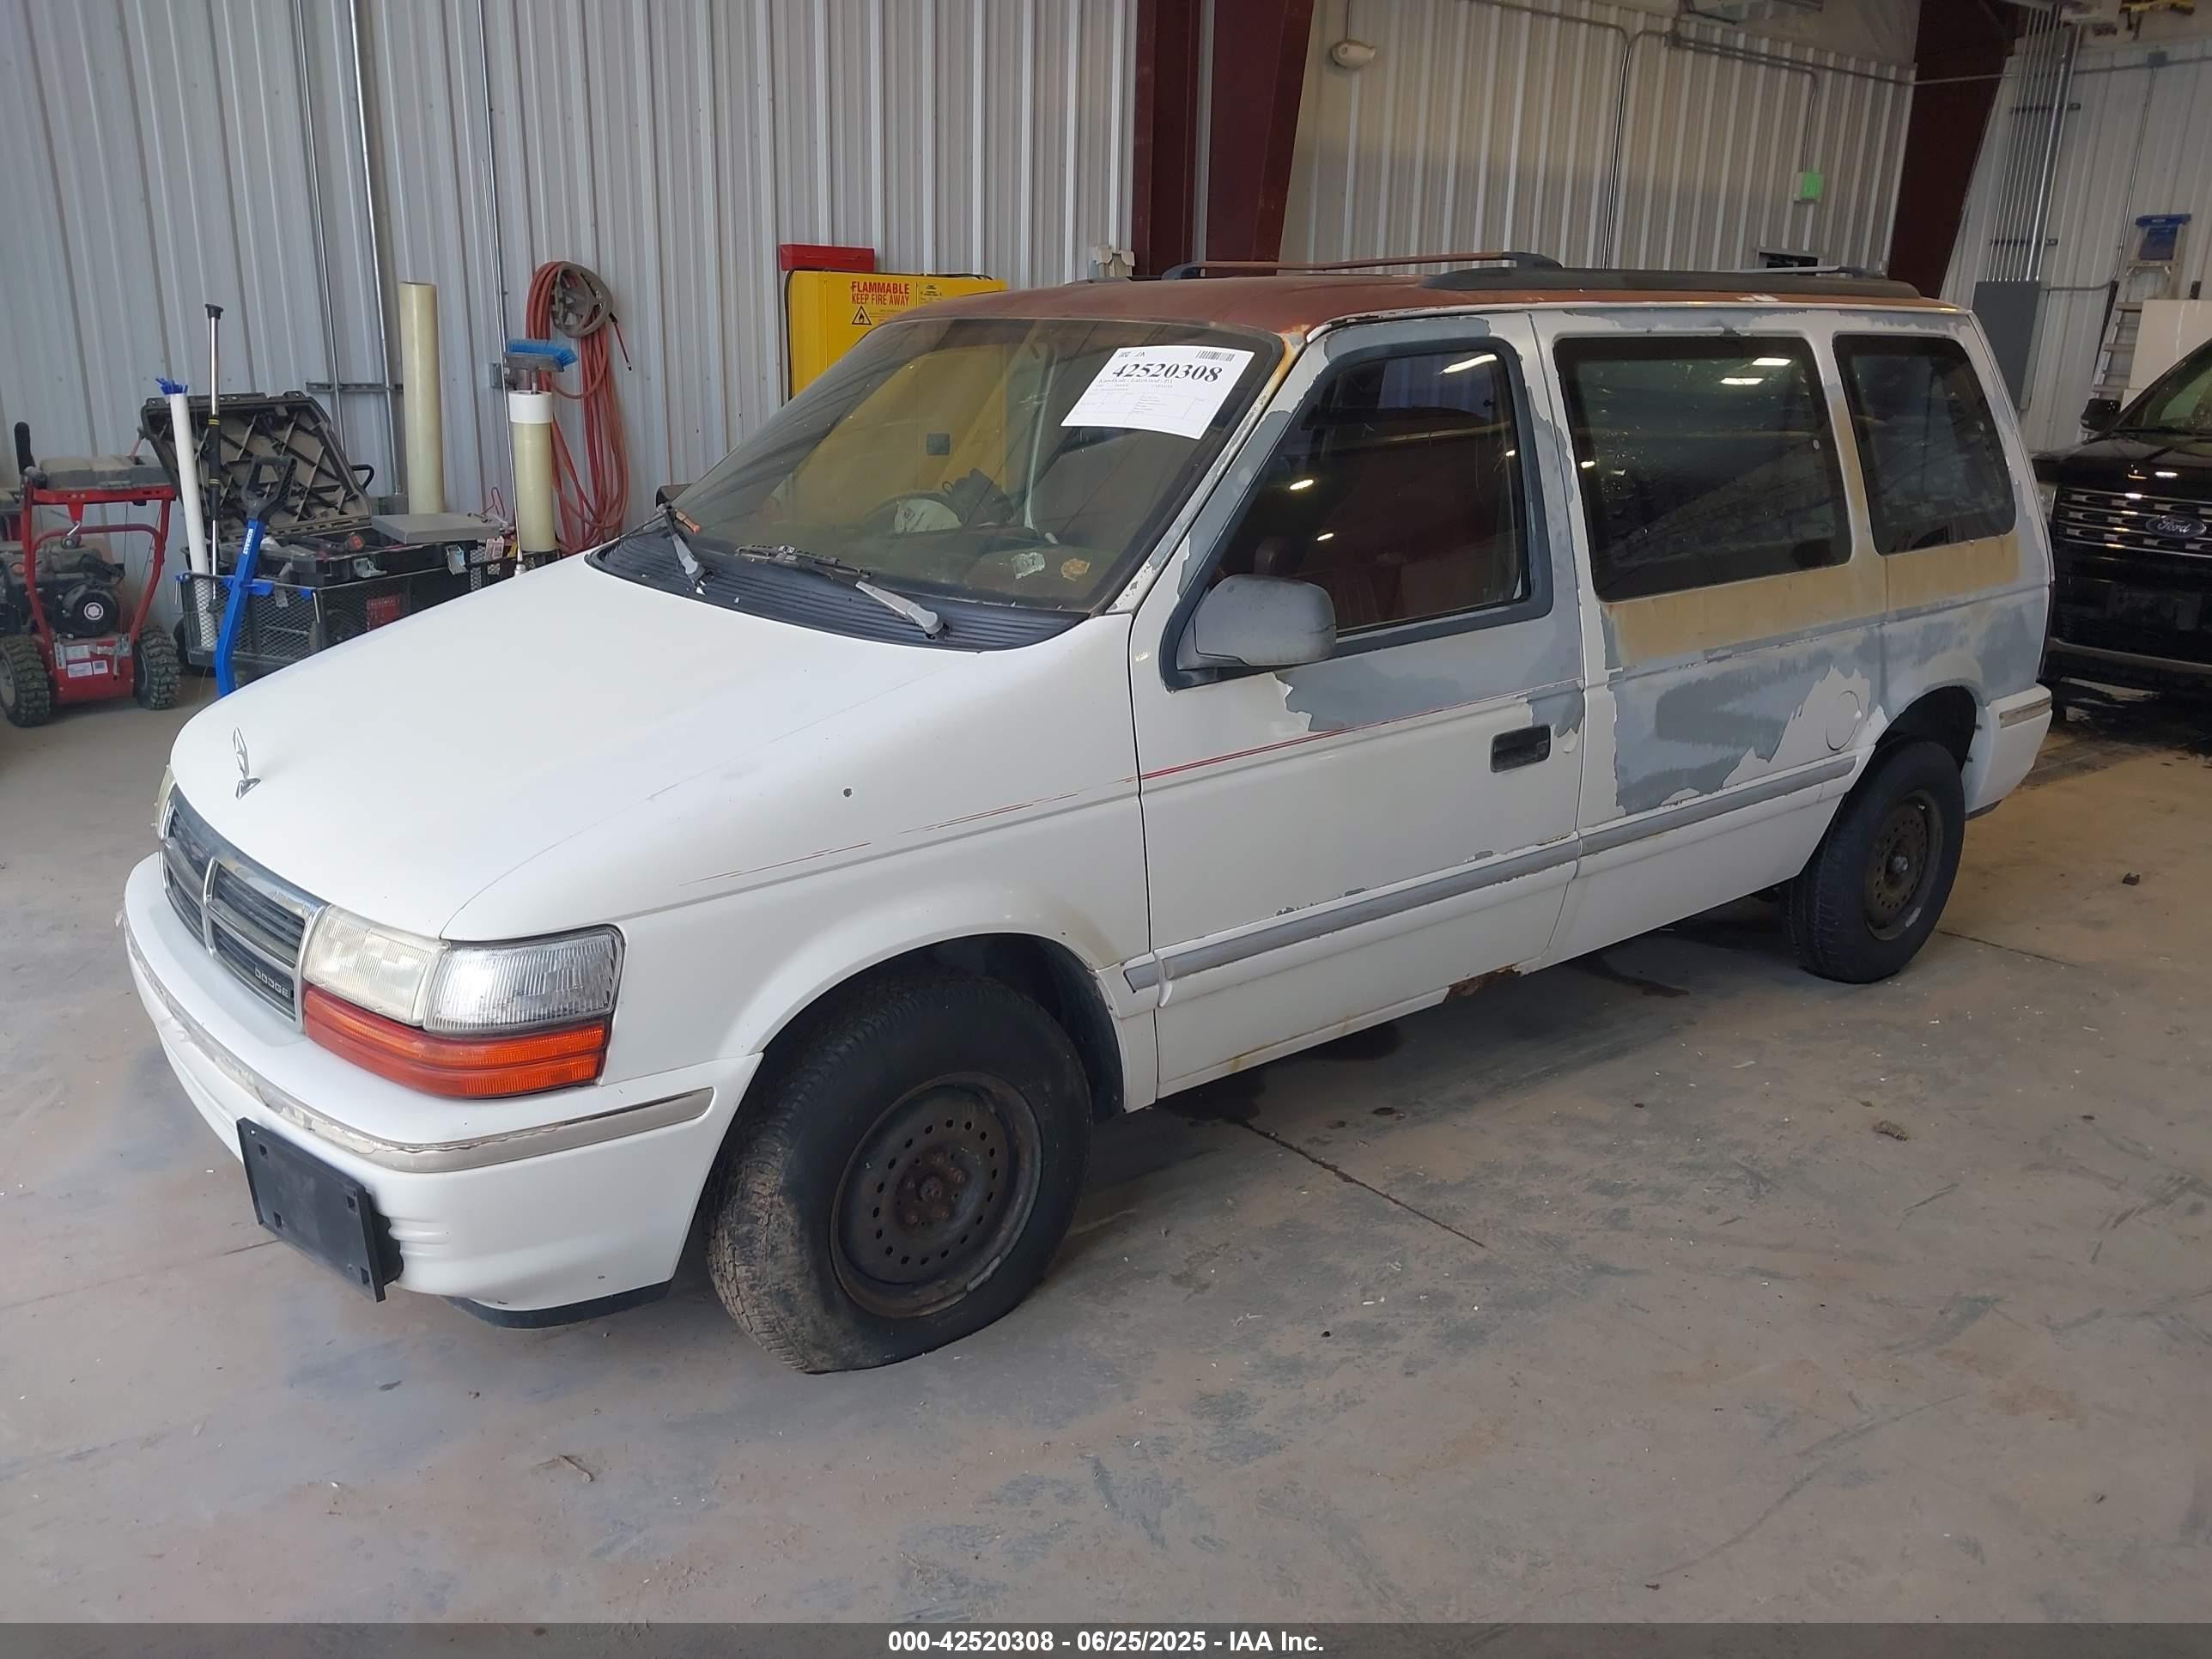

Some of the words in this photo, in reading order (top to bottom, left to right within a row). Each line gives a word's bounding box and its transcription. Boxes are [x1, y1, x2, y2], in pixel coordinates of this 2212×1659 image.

[852, 281, 909, 295] FLAMMABLE
[852, 293, 868, 305] KEEP
[872, 294, 887, 306] FIRE
[889, 294, 909, 307] AWAY
[1112, 363, 1223, 383] 42520308
[2157, 520, 2191, 533] Ford
[254, 968, 289, 999] DODGE
